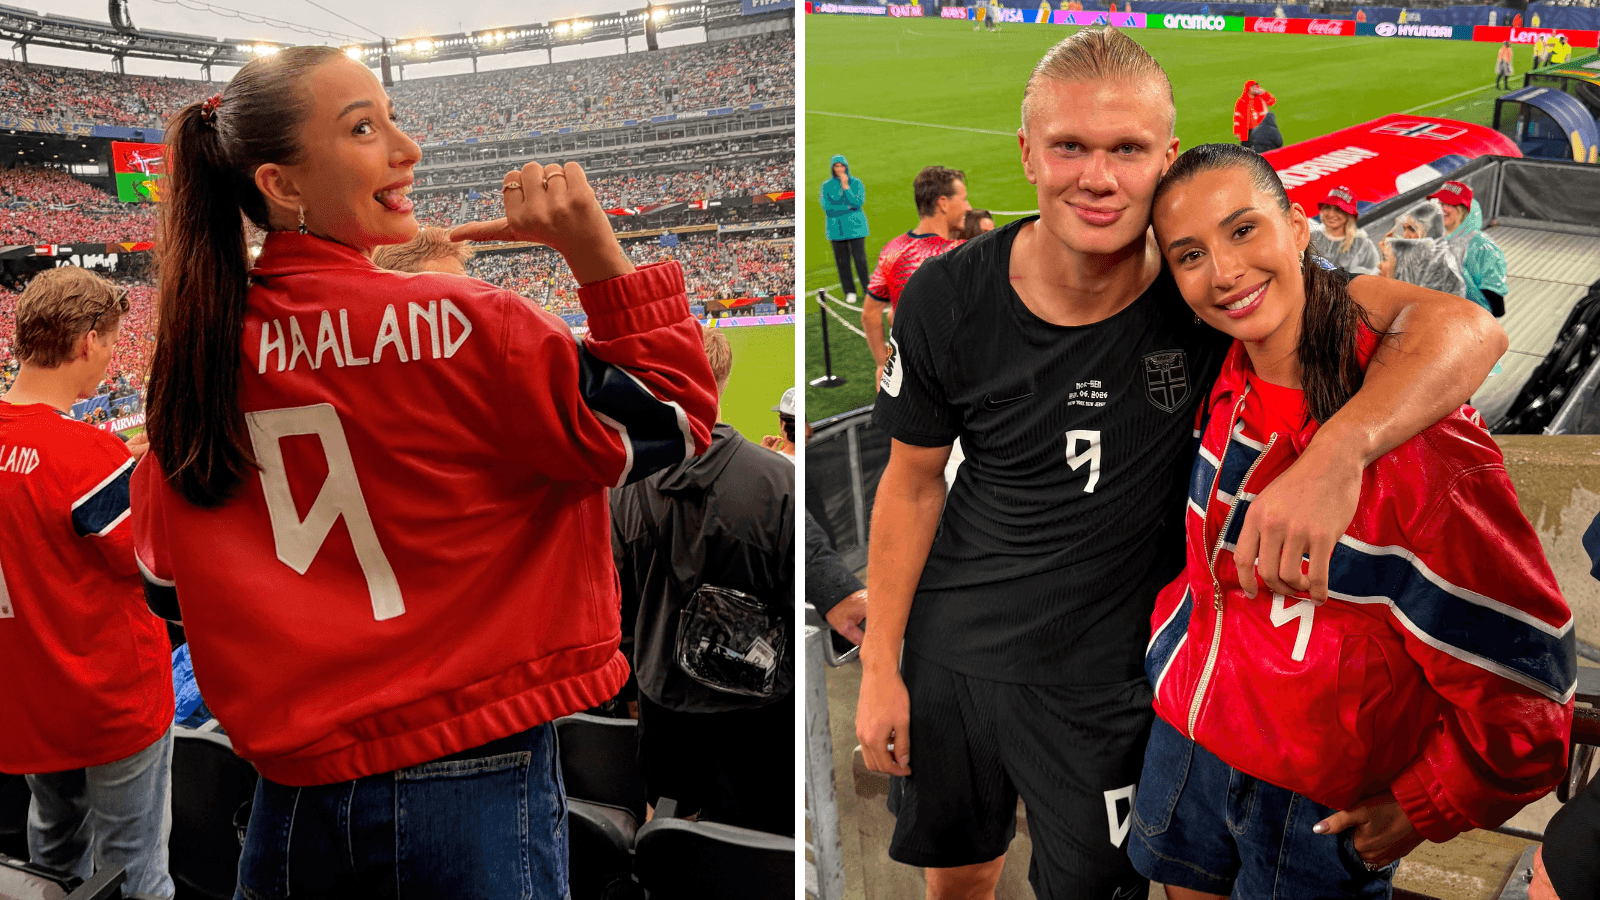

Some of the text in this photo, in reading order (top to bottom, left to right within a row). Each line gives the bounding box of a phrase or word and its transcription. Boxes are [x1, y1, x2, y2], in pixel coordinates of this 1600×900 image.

[998, 8, 1024, 23] VISA
[1163, 14, 1226, 31] aramco
[1397, 24, 1453, 38] HYUNDAI
[258, 298, 473, 374] HAALAND
[110, 412, 147, 433] AIRWAY
[0, 444, 40, 474] LAND
[1065, 429, 1101, 494] 9
[245, 402, 406, 622] 9
